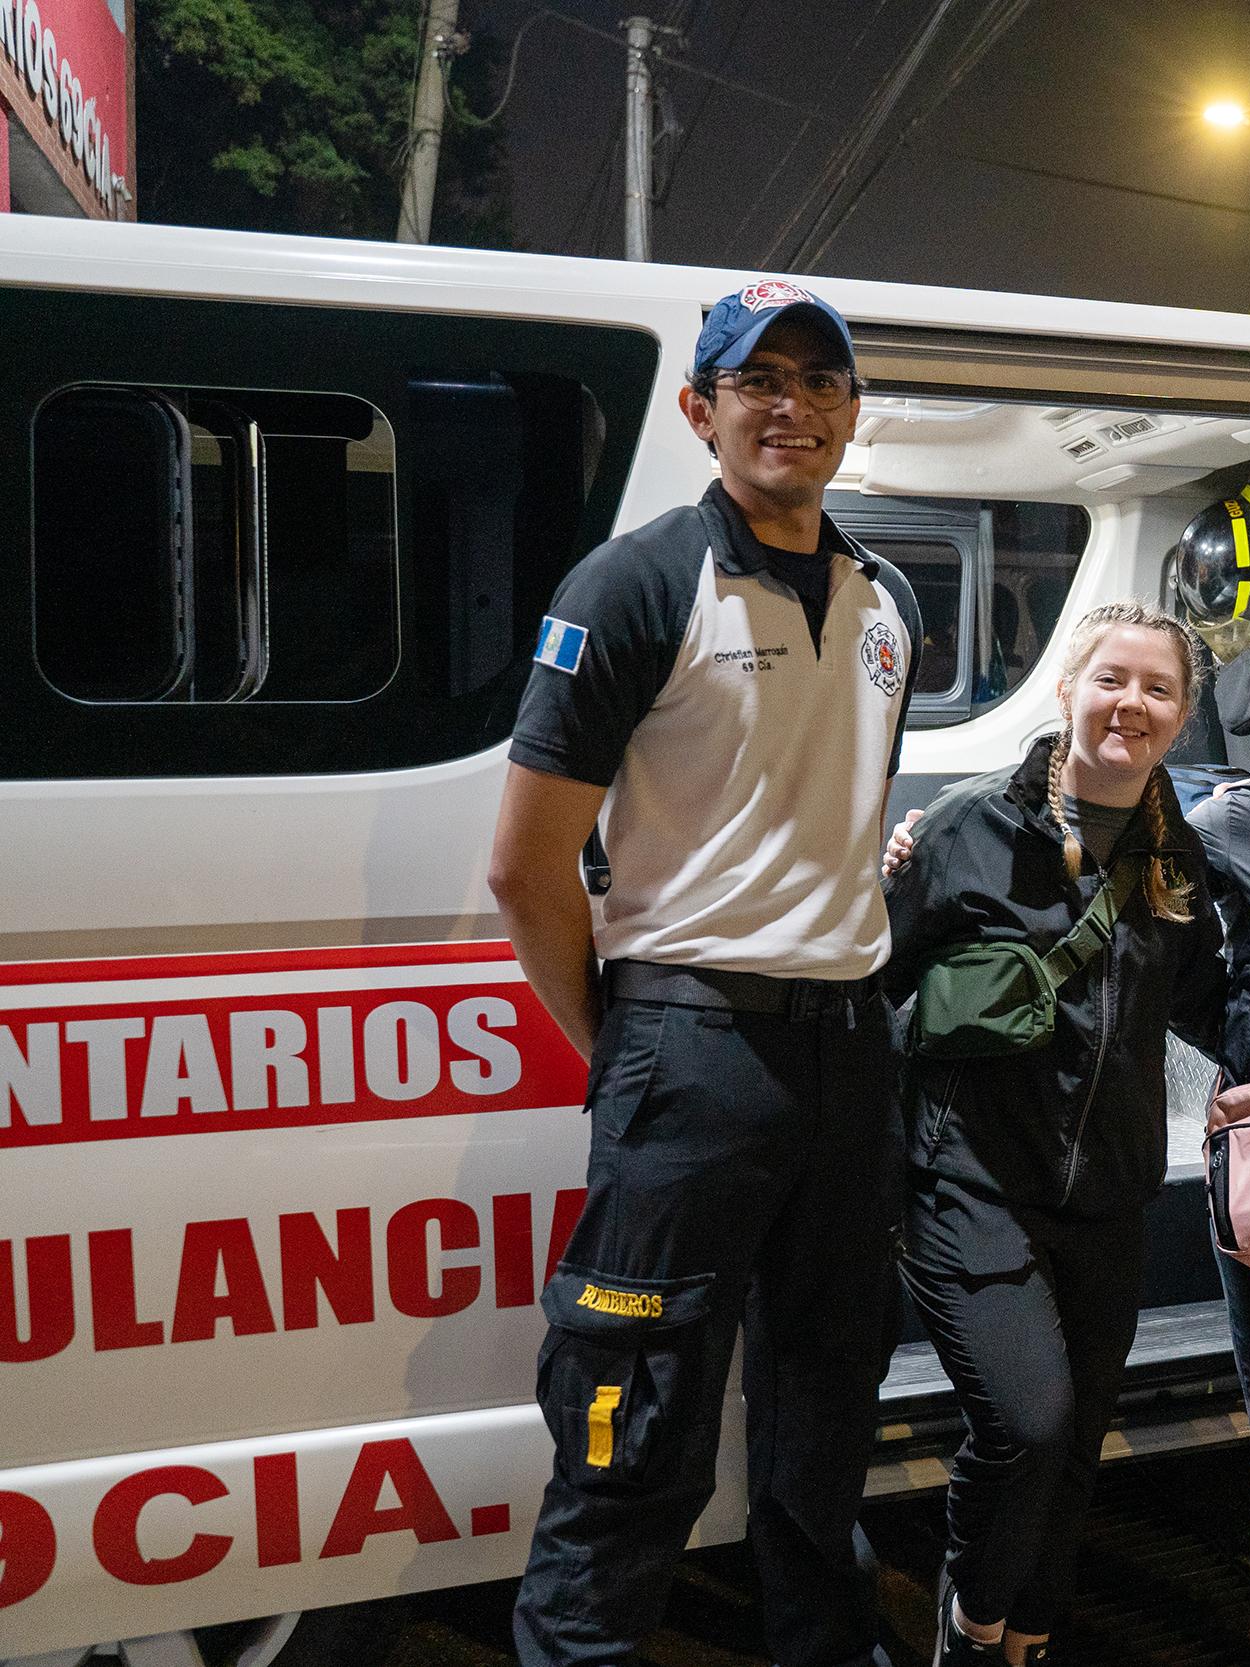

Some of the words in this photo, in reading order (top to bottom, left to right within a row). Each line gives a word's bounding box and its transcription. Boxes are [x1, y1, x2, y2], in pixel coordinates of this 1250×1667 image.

[742, 662, 754, 672] 69
[0, 996, 523, 1129] NTARIOS
[576, 1283, 663, 1318] BOMBEROS
[93, 1437, 511, 1586] CIA.
